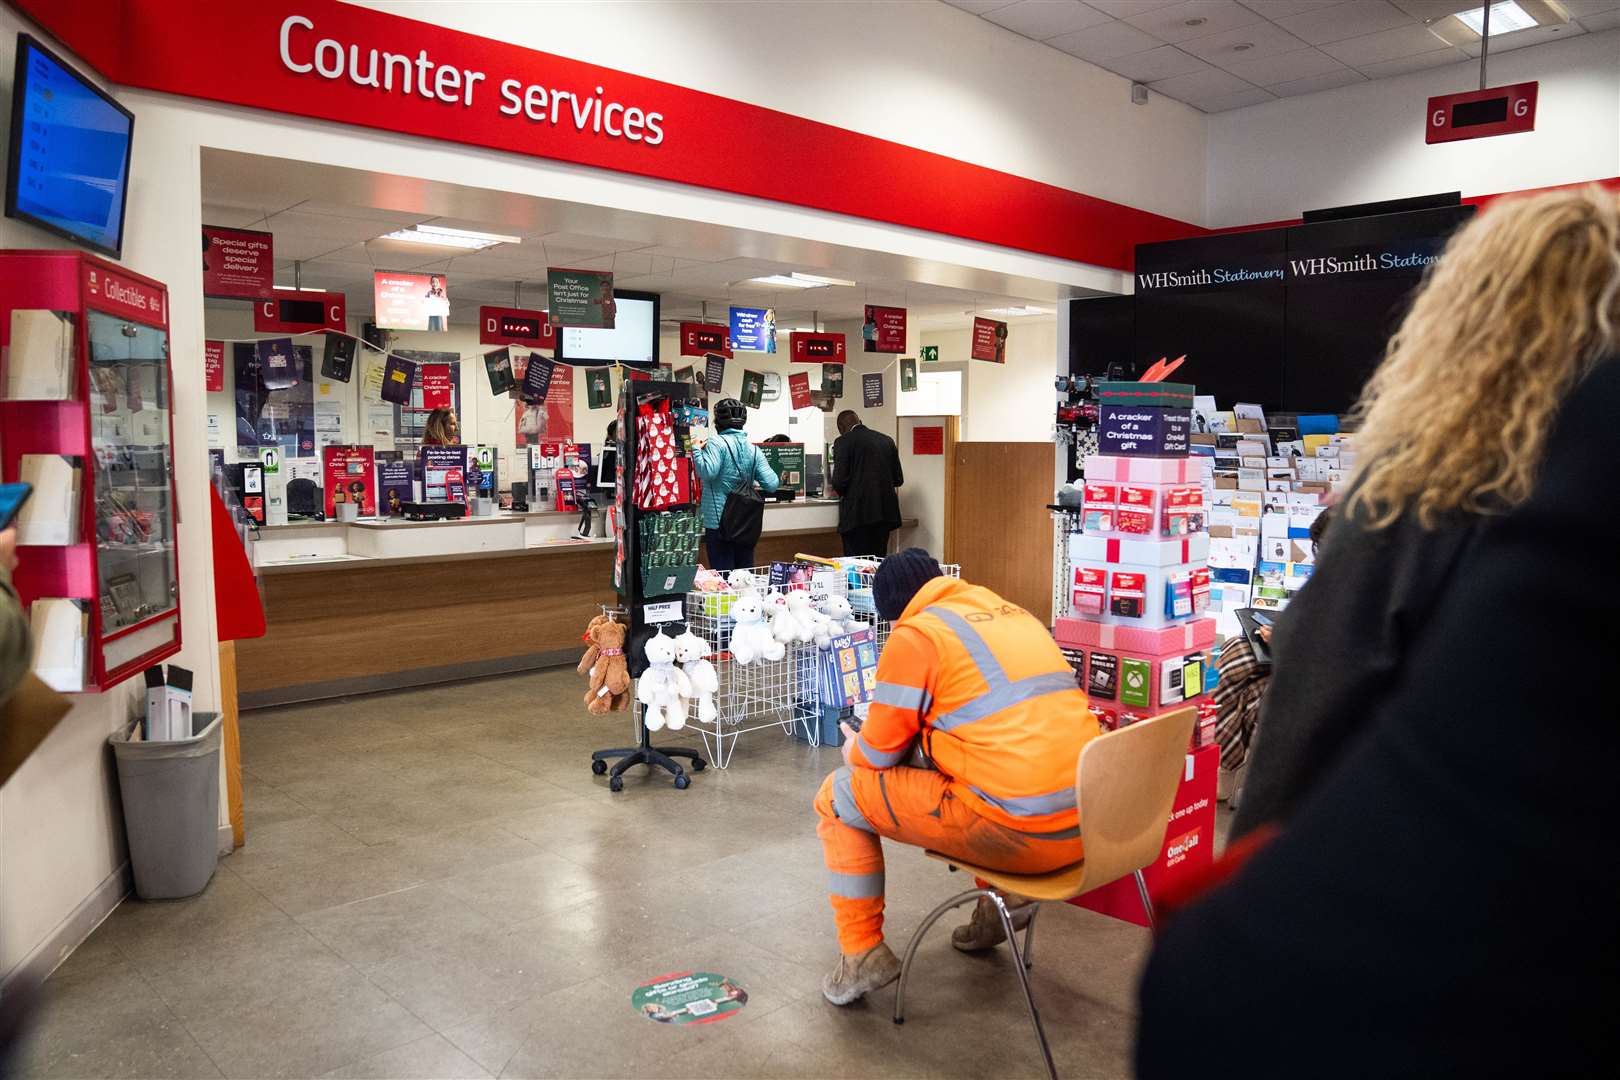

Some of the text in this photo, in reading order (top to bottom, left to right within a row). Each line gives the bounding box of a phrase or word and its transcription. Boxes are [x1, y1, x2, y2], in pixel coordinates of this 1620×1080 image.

[279, 15, 664, 146] Counter services
[1514, 98, 1528, 116] G
[1432, 110, 1446, 126] G
[212, 237, 268, 250] Special gifts
[222, 247, 260, 256] deserve
[224, 256, 257, 264] special
[1290, 254, 1378, 278] WHSmith
[224, 263, 258, 274] delivery
[1139, 267, 1284, 290] WHSmith Stationery
[104, 278, 146, 310] Collectibles
[555, 297, 588, 306] Christmas
[263, 302, 274, 318] C
[330, 306, 340, 322] C
[487, 318, 497, 332] D
[544, 323, 552, 337] D
[688, 332, 695, 345] E
[725, 336, 730, 348] E
[797, 341, 804, 353] F
[836, 342, 843, 354] F
[1117, 413, 1152, 421] cracker
[1106, 431, 1153, 440] Christmas
[1121, 442, 1137, 450] gift
[1186, 804, 1194, 815] up
[1194, 798, 1208, 810] today
